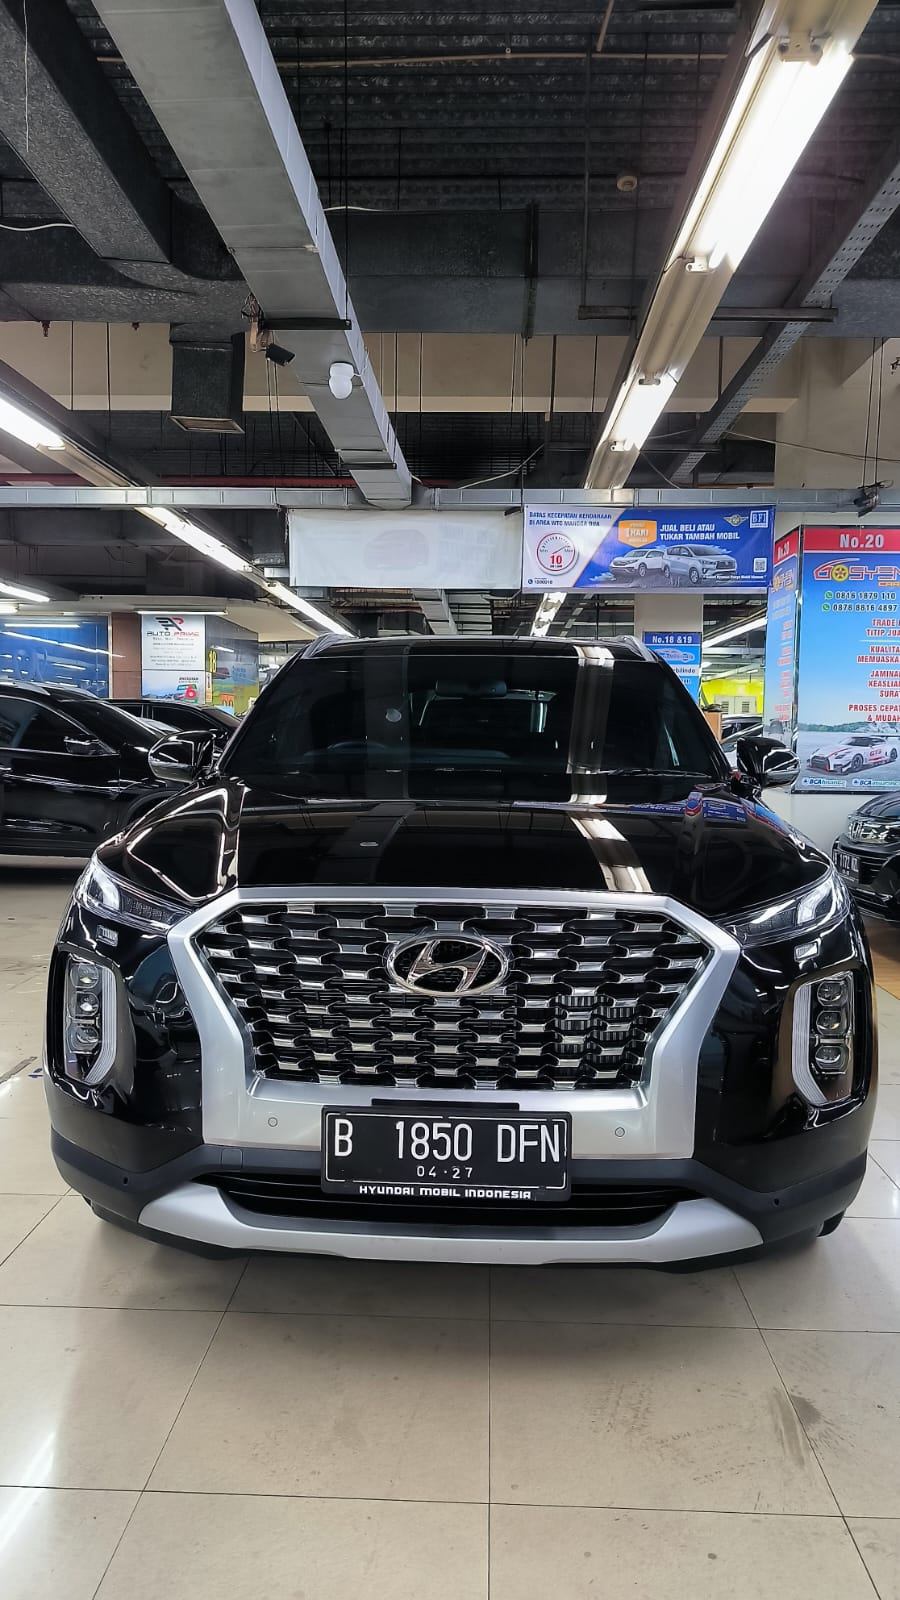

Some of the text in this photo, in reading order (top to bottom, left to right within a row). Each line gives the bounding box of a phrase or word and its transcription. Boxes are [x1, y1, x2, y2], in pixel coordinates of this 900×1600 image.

[660, 523, 715, 532] JUAL BELI ATAU
[660, 532, 740, 541] TUKAR TAMBAH MOBIL
[839, 533, 884, 549] No.20
[549, 555, 563, 565] 10
[872, 618, 896, 627] TRADE
[865, 628, 885, 637] TITIP
[651, 635, 674, 644] No.18
[848, 704, 878, 713] PROSES
[867, 714, 873, 722] &
[334, 1118, 560, 1164] B 1850 DFN
[359, 1185, 531, 1200] HYUNDAI MOBIL INDONESIA
